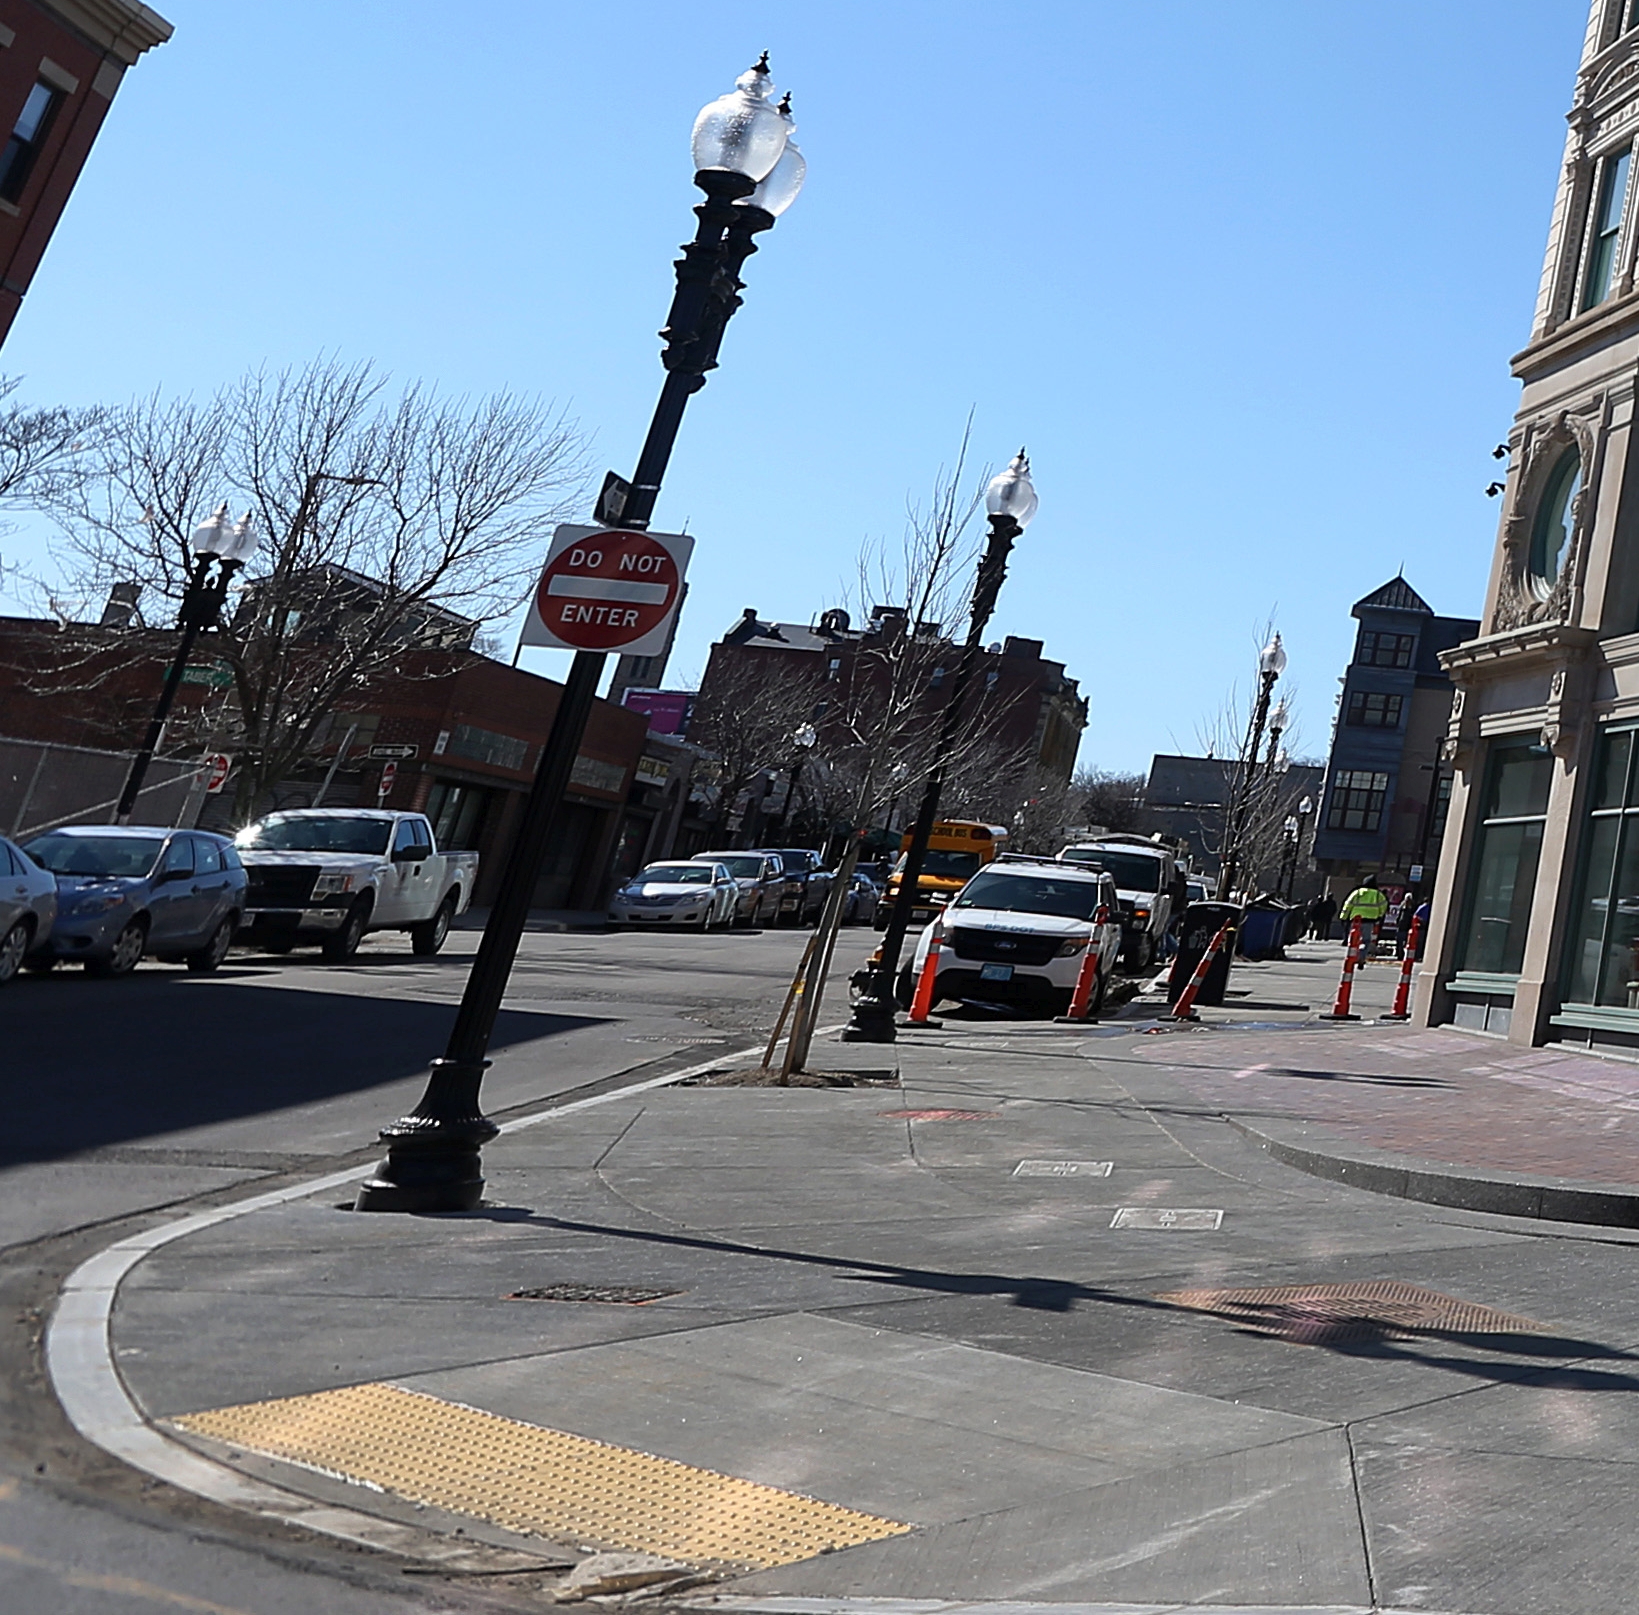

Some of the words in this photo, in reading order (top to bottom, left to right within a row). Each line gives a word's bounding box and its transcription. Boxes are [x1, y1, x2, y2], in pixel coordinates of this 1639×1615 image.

[569, 549, 603, 568] DO
[619, 554, 666, 574] NOT
[560, 605, 639, 627] ENTER
